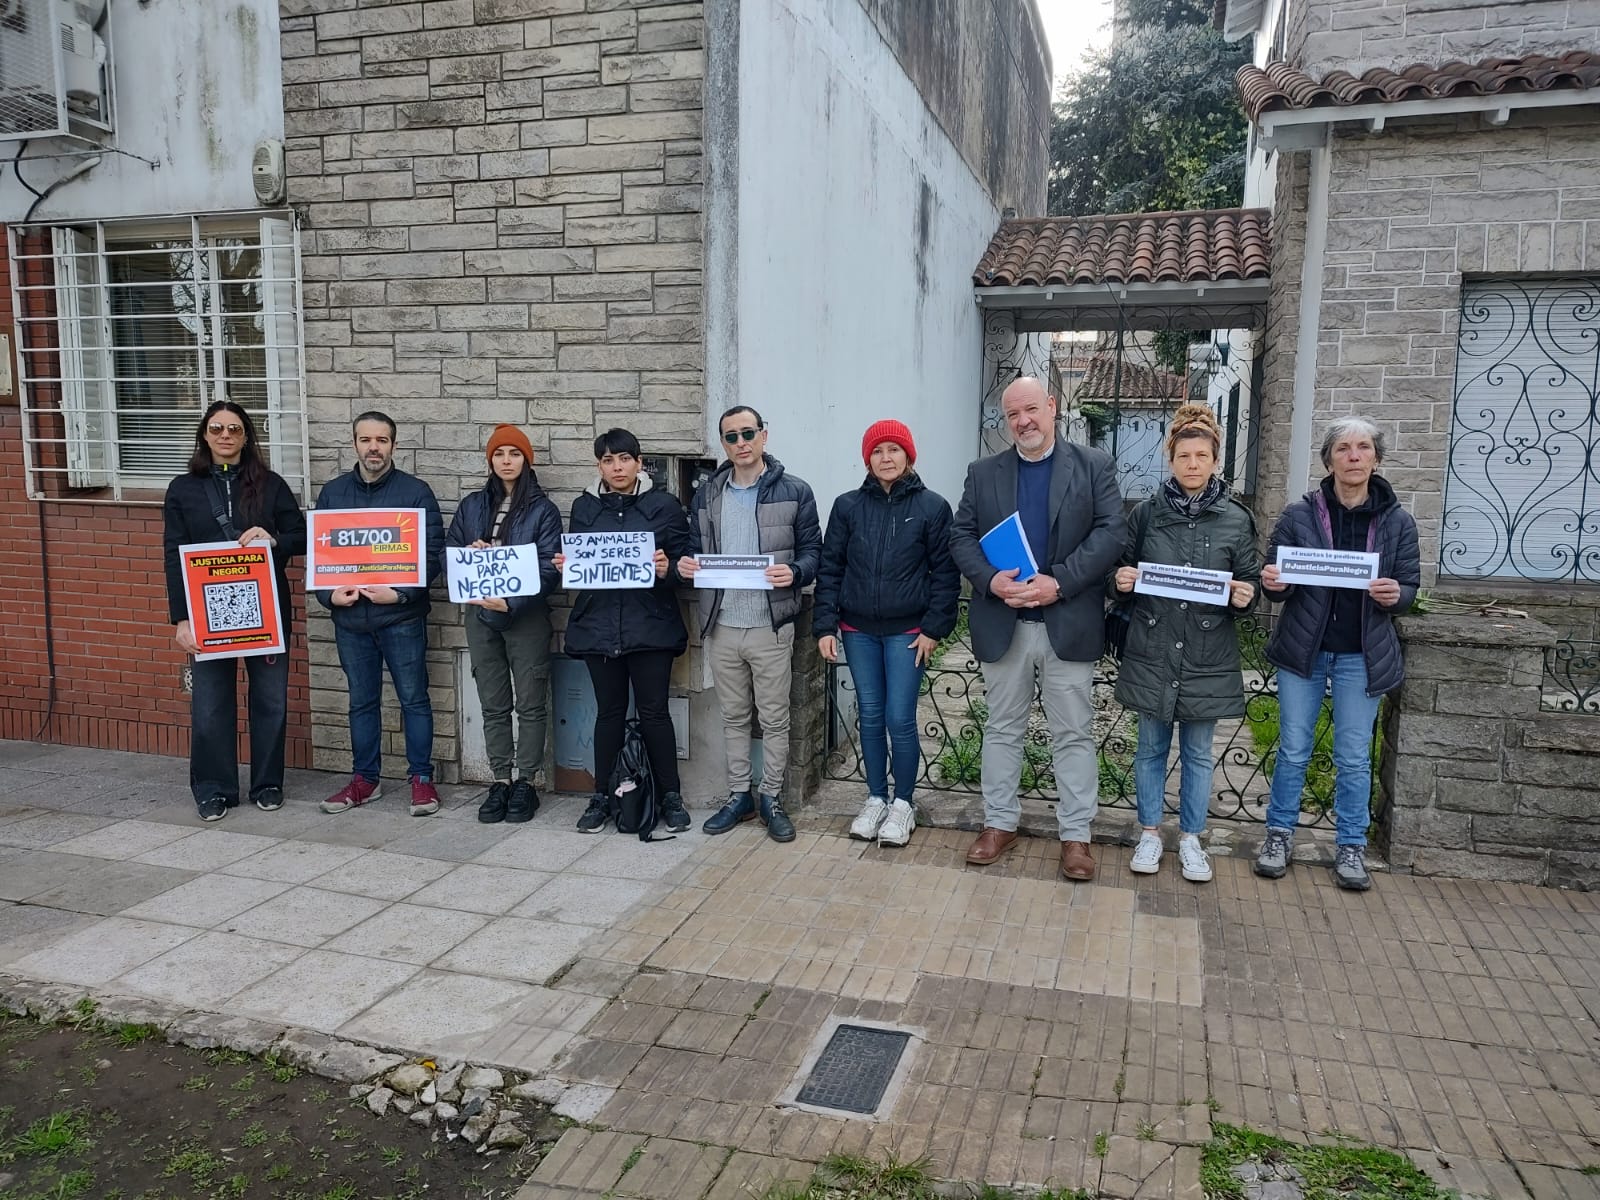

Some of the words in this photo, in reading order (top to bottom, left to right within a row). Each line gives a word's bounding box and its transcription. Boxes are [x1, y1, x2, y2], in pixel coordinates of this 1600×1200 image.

[338, 529, 393, 546] 81.700
[563, 534, 583, 546] LOS
[587, 532, 648, 546] ANIMALES
[374, 543, 409, 552] FIRMAS
[575, 548, 596, 559] SON
[601, 546, 641, 559] SERES
[238, 554, 264, 564] PARA
[456, 547, 520, 566] JUSTICIA
[1333, 553, 1365, 561] pedimos
[212, 566, 248, 577] NEGRO!
[477, 562, 510, 579] PARA
[568, 562, 653, 584] SINTIENTES
[1190, 568, 1219, 579] pedimos
[1284, 562, 1369, 576] #JusticiaParaNegro
[457, 576, 522, 599] NEGRO
[1144, 573, 1222, 592] #JusticiaParaNegro
